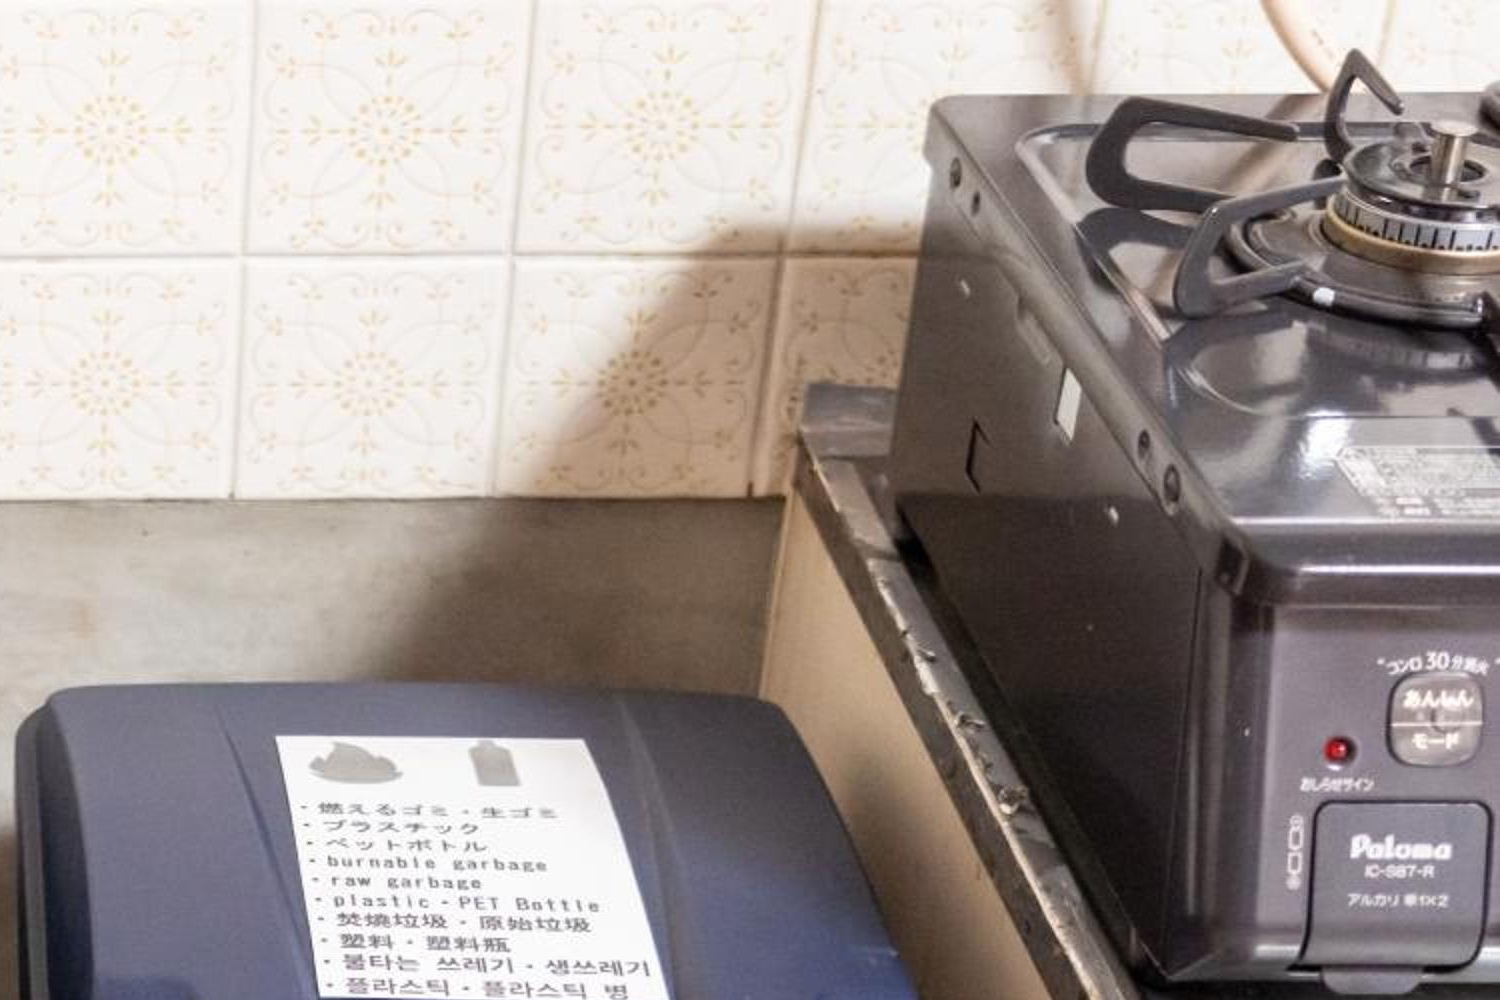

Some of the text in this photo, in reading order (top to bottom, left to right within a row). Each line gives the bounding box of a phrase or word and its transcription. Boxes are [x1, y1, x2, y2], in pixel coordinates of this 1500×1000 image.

[1351, 835, 1451, 859] Paloma
[327, 855, 547, 872] burnable garbage
[332, 876, 481, 890] raw garbage
[334, 894, 599, 912] plastic PET Bottle
